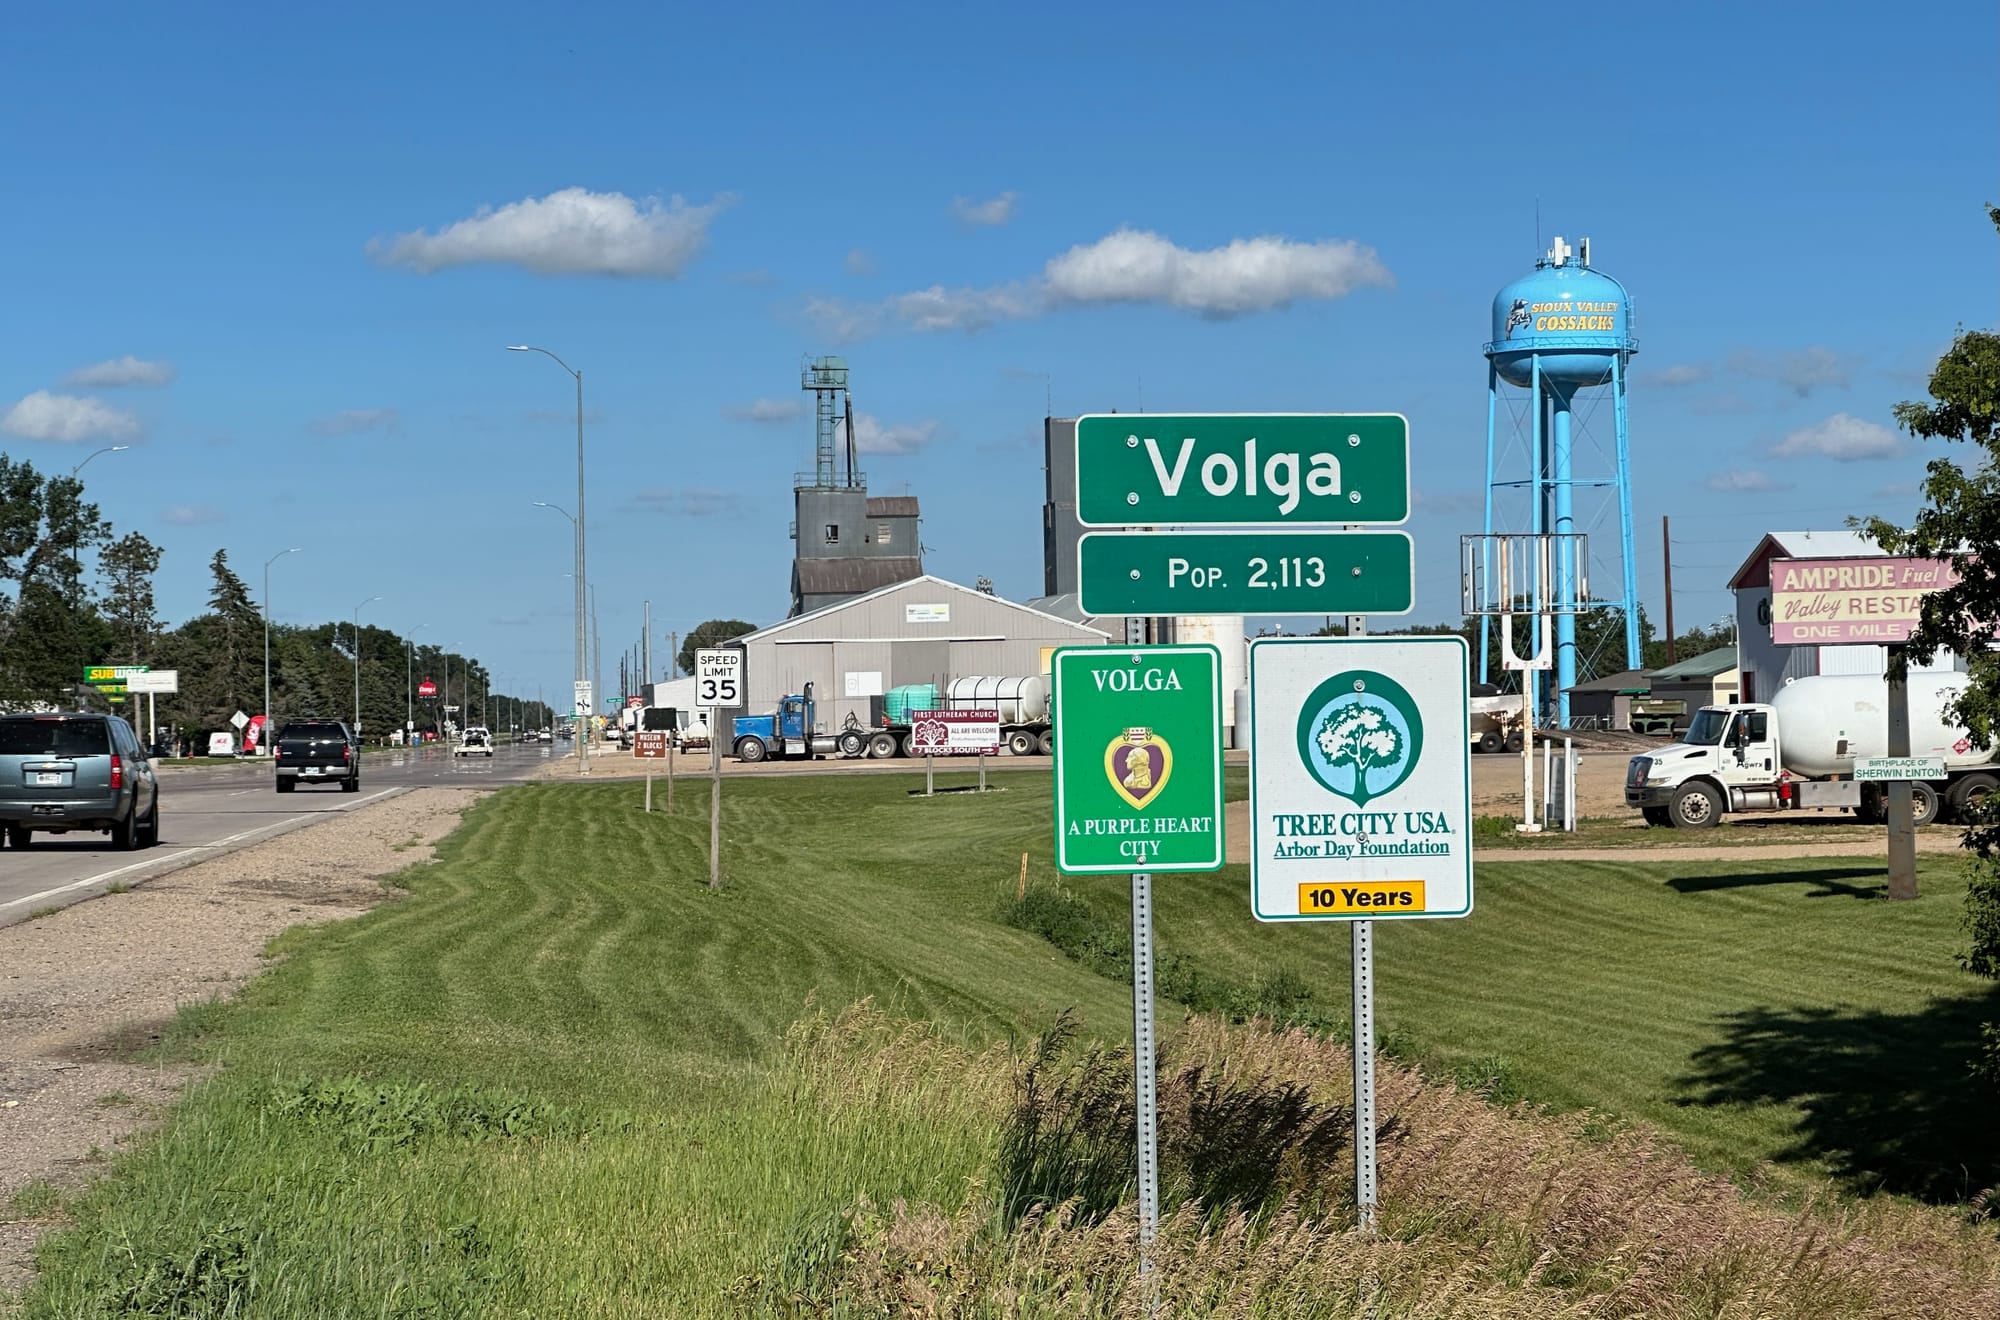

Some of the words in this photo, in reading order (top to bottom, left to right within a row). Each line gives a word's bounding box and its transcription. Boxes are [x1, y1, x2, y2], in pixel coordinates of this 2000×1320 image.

[1531, 302, 1574, 313] SIOUX
[1576, 302, 1618, 312] VALLEY
[1536, 315, 1614, 331] COSSACKS
[1143, 437, 1342, 516] Volga
[1247, 556, 1326, 591] 2,113
[1782, 564, 1897, 591] AMPRIDE
[1902, 566, 1940, 584] Fuel
[1784, 593, 1842, 621] Valley
[1792, 625, 1841, 639] ONE
[1849, 623, 1903, 637] MILE
[700, 655, 738, 665] SPEED
[704, 667, 734, 677] LIMIT
[1091, 668, 1183, 692] VOLGA
[701, 679, 737, 700] 35
[1654, 758, 1663, 766] 35
[1868, 759, 1917, 767] BIRTHPLACE
[1856, 768, 1903, 778] SHERWIN
[1905, 768, 1943, 778] LINTON
[1068, 819, 1081, 836] A
[1085, 817, 1150, 836] PURPLE
[1153, 816, 1212, 834] HEART
[1272, 814, 1337, 837] TREE
[1340, 812, 1399, 836] CITY
[1119, 839, 1162, 857] CITY
[1273, 841, 1321, 857] Arbor
[1323, 840, 1355, 861] Day
[1359, 838, 1450, 857] Foundation
[1309, 888, 1336, 908] 10
[1341, 887, 1413, 907] Years
